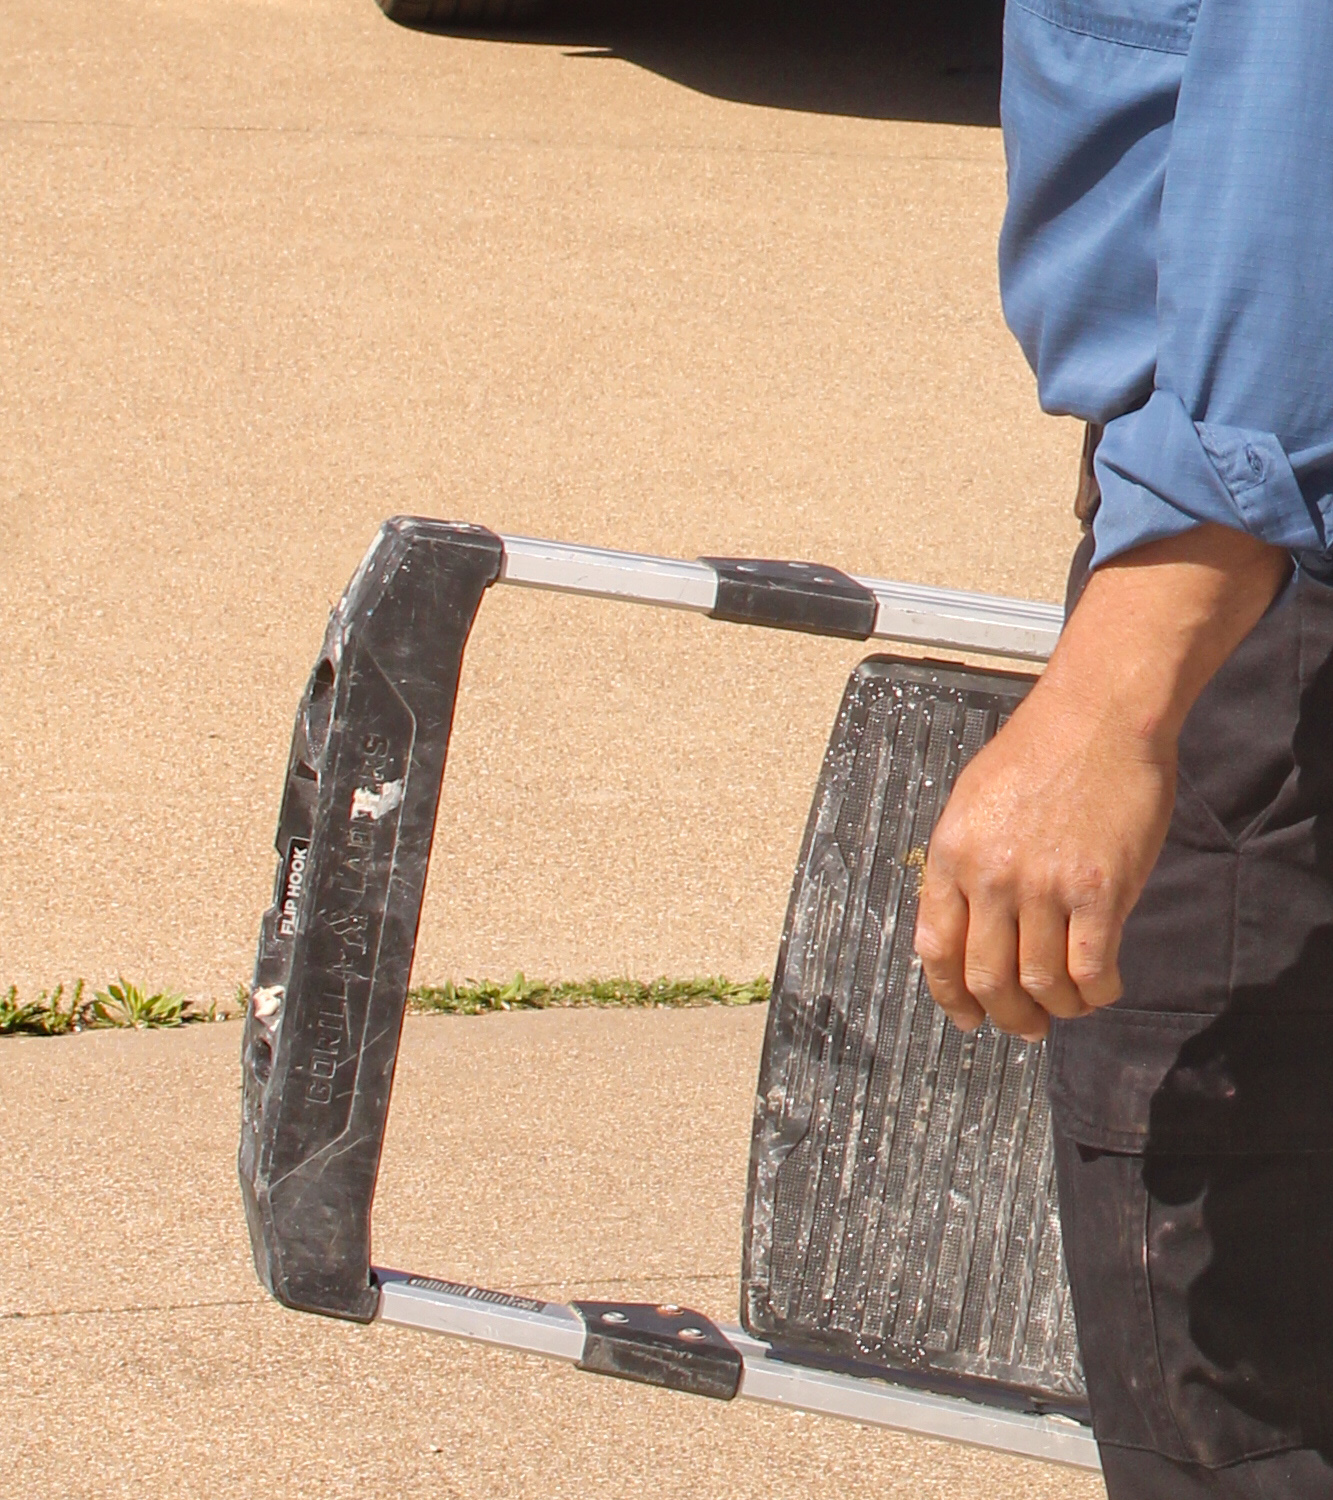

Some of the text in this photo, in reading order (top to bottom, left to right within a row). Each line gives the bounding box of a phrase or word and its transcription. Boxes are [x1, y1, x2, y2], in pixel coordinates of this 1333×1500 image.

[281, 846, 308, 935] FLIP HOOK
[305, 955, 366, 1104] GORILLA
